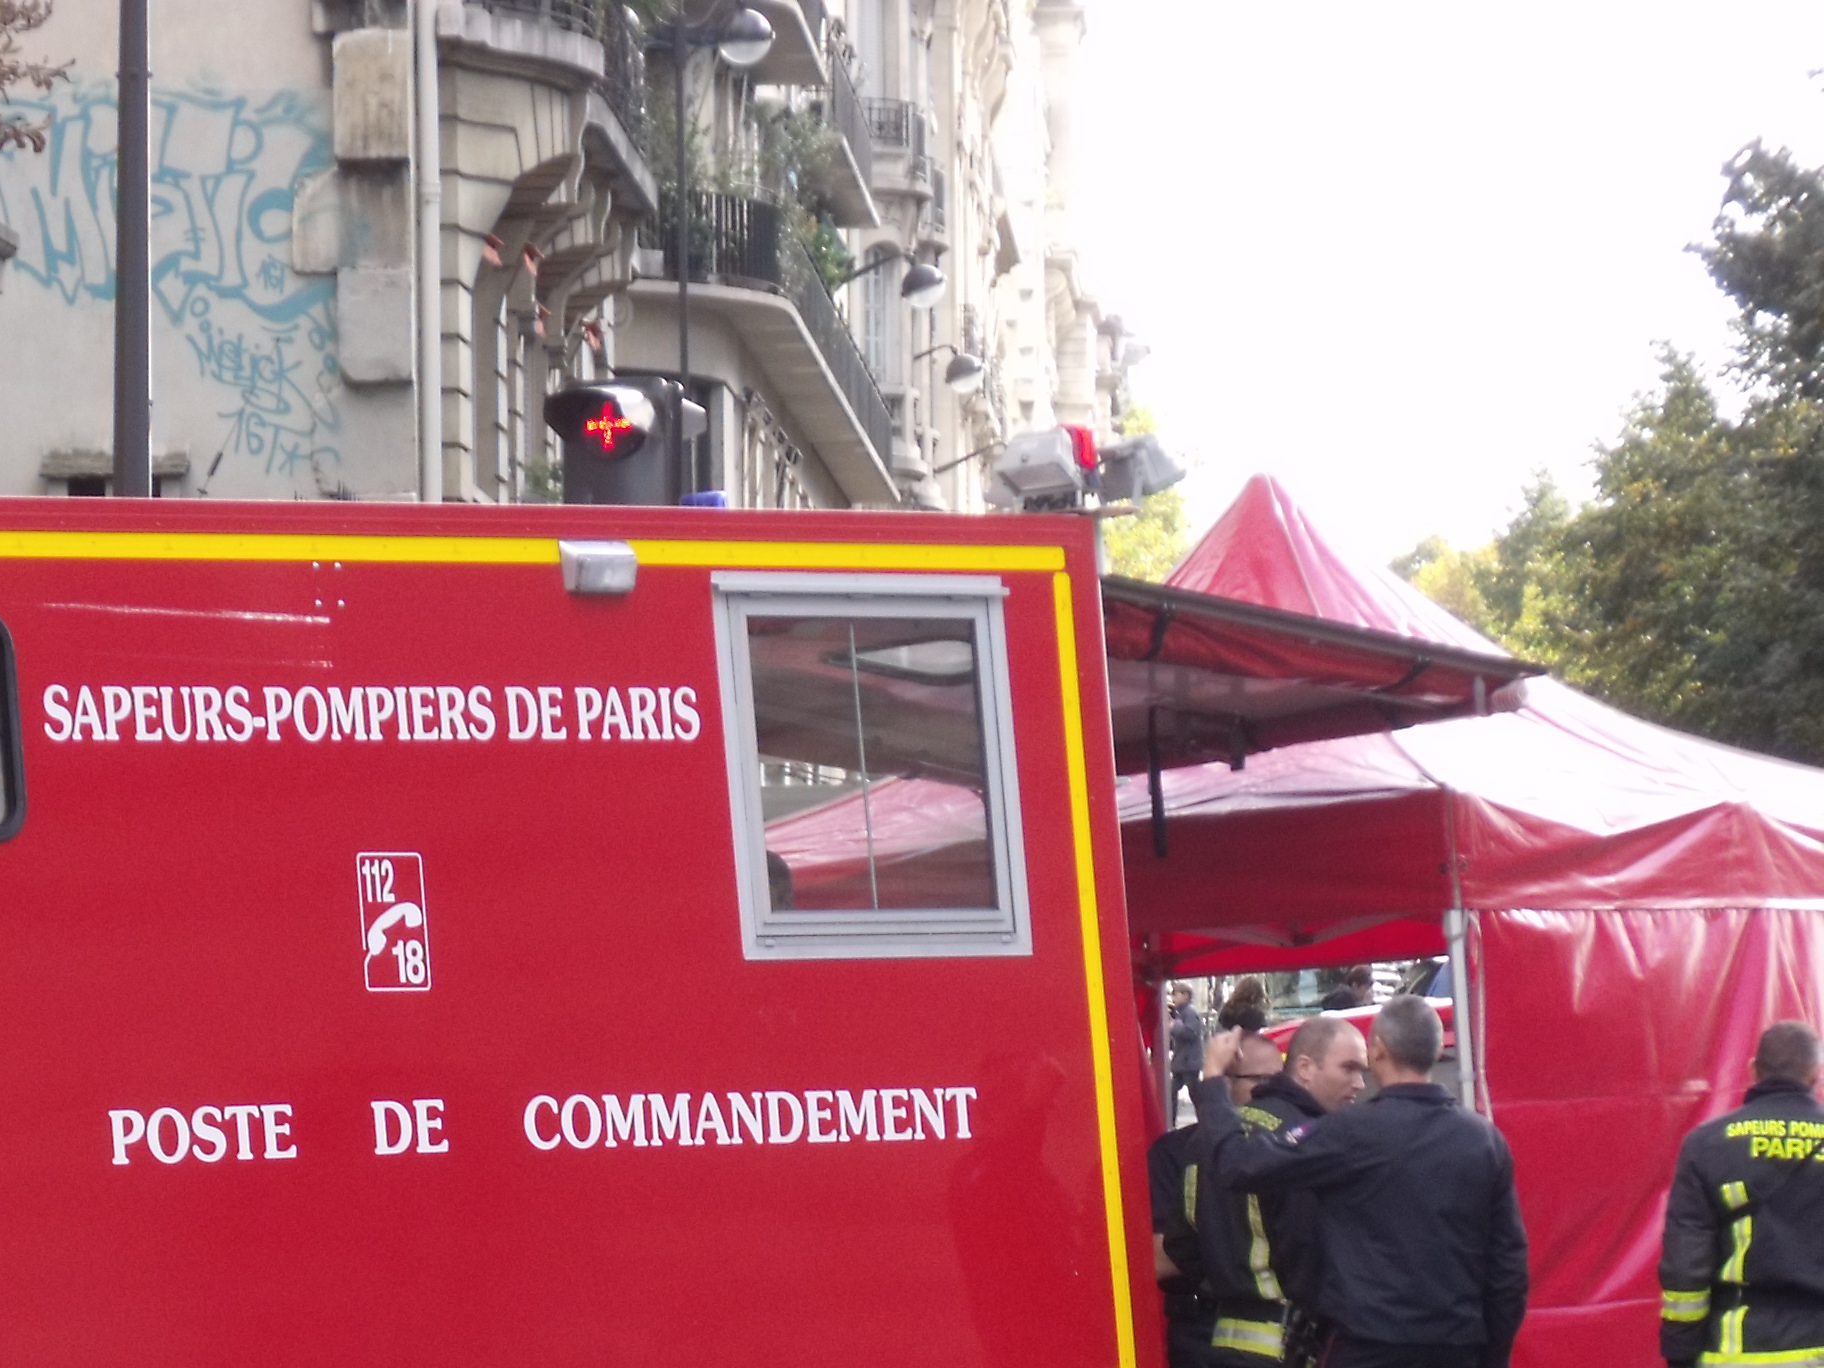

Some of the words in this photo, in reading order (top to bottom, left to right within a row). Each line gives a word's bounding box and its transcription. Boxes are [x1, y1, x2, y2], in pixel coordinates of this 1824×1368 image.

[42, 684, 497, 742] SAPEURS-POMPIERS
[506, 686, 568, 741] DE
[575, 686, 702, 742] PARIS
[362, 858, 396, 902] 112
[391, 938, 426, 984] 18
[107, 1103, 298, 1165] POSTE
[370, 1098, 450, 1155] DE
[523, 1086, 977, 1151] COMMANDEMENT
[1726, 1119, 1787, 1137] SAPEURS
